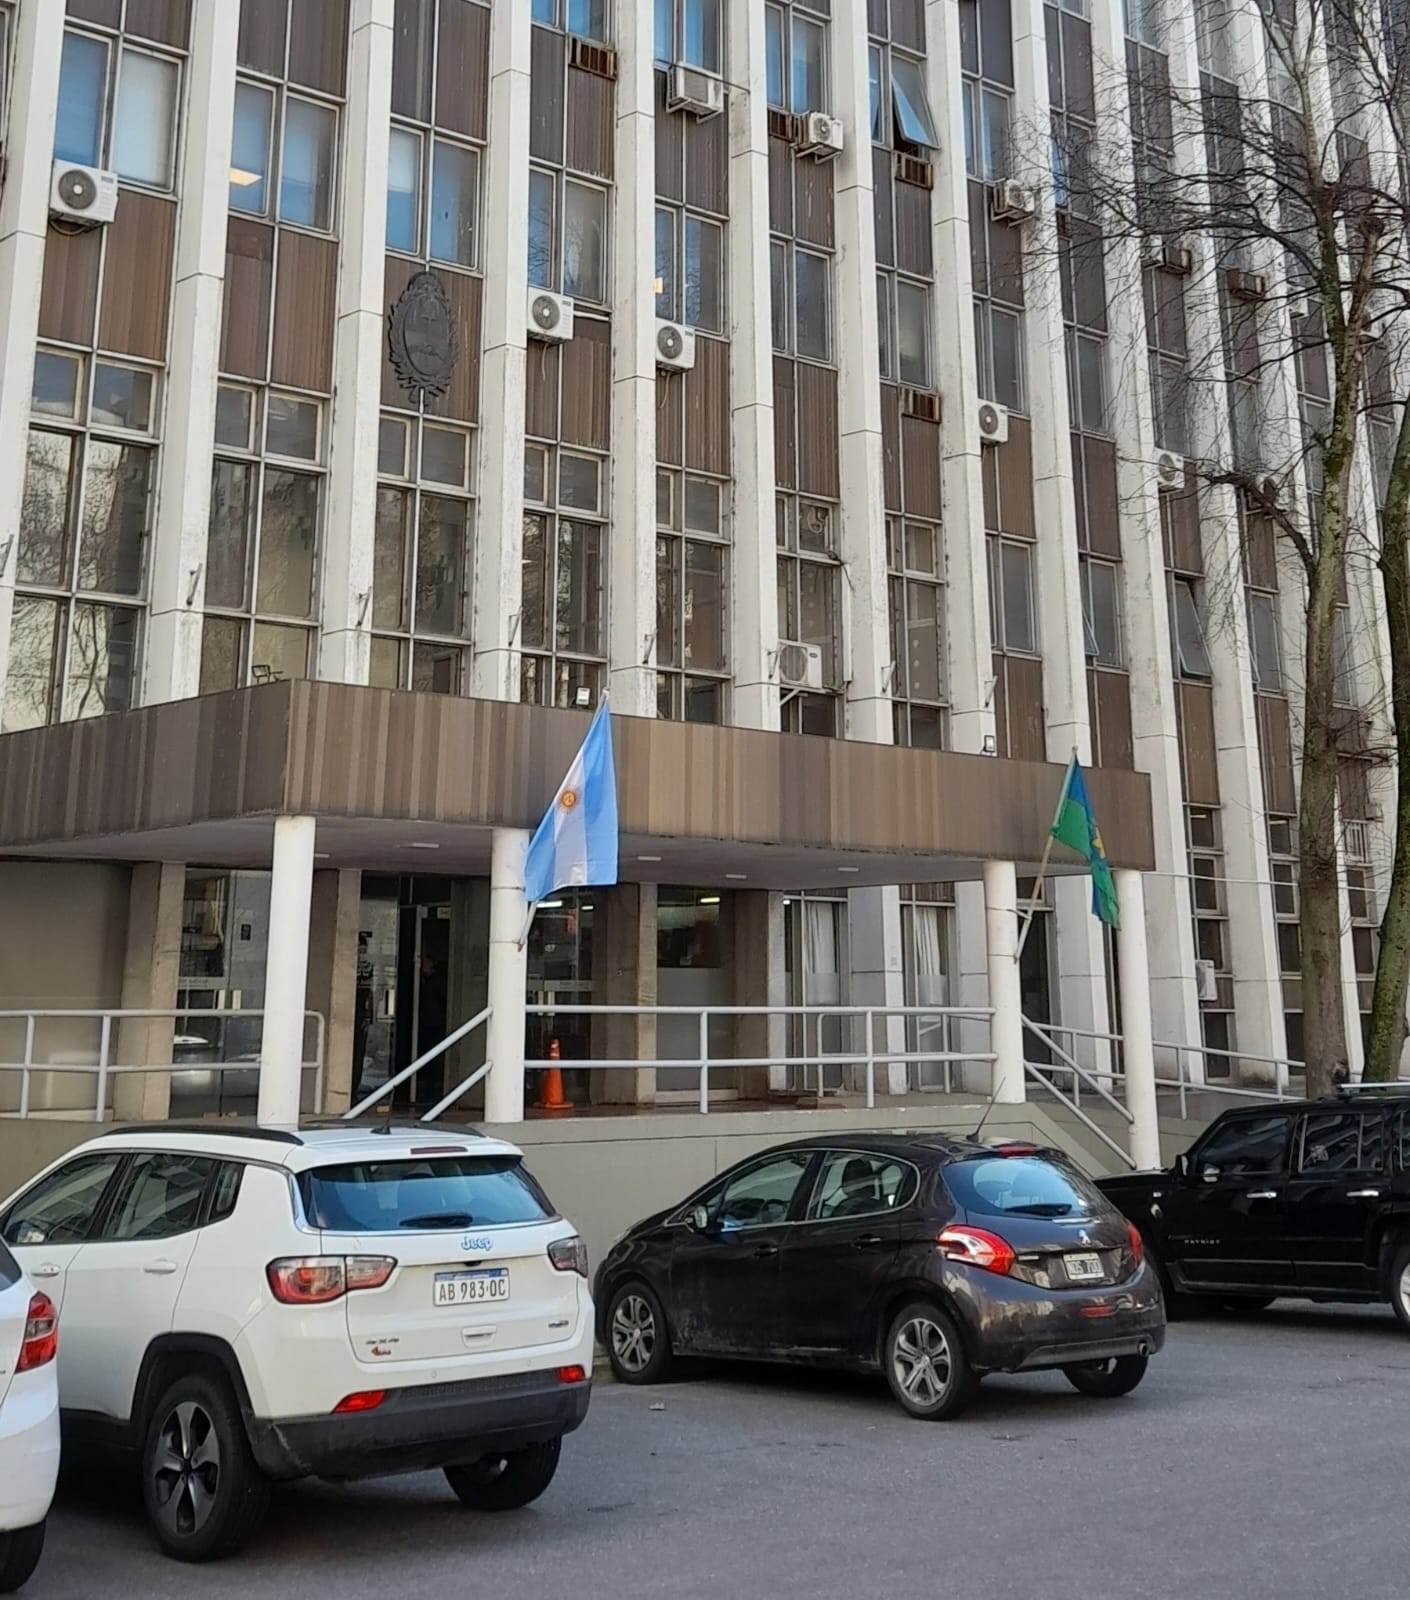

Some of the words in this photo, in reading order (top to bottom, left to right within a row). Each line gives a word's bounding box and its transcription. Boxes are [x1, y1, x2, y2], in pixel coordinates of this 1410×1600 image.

[461, 1237, 493, 1251] Jeep
[439, 1283, 456, 1302] AB
[460, 1279, 485, 1300] 983
